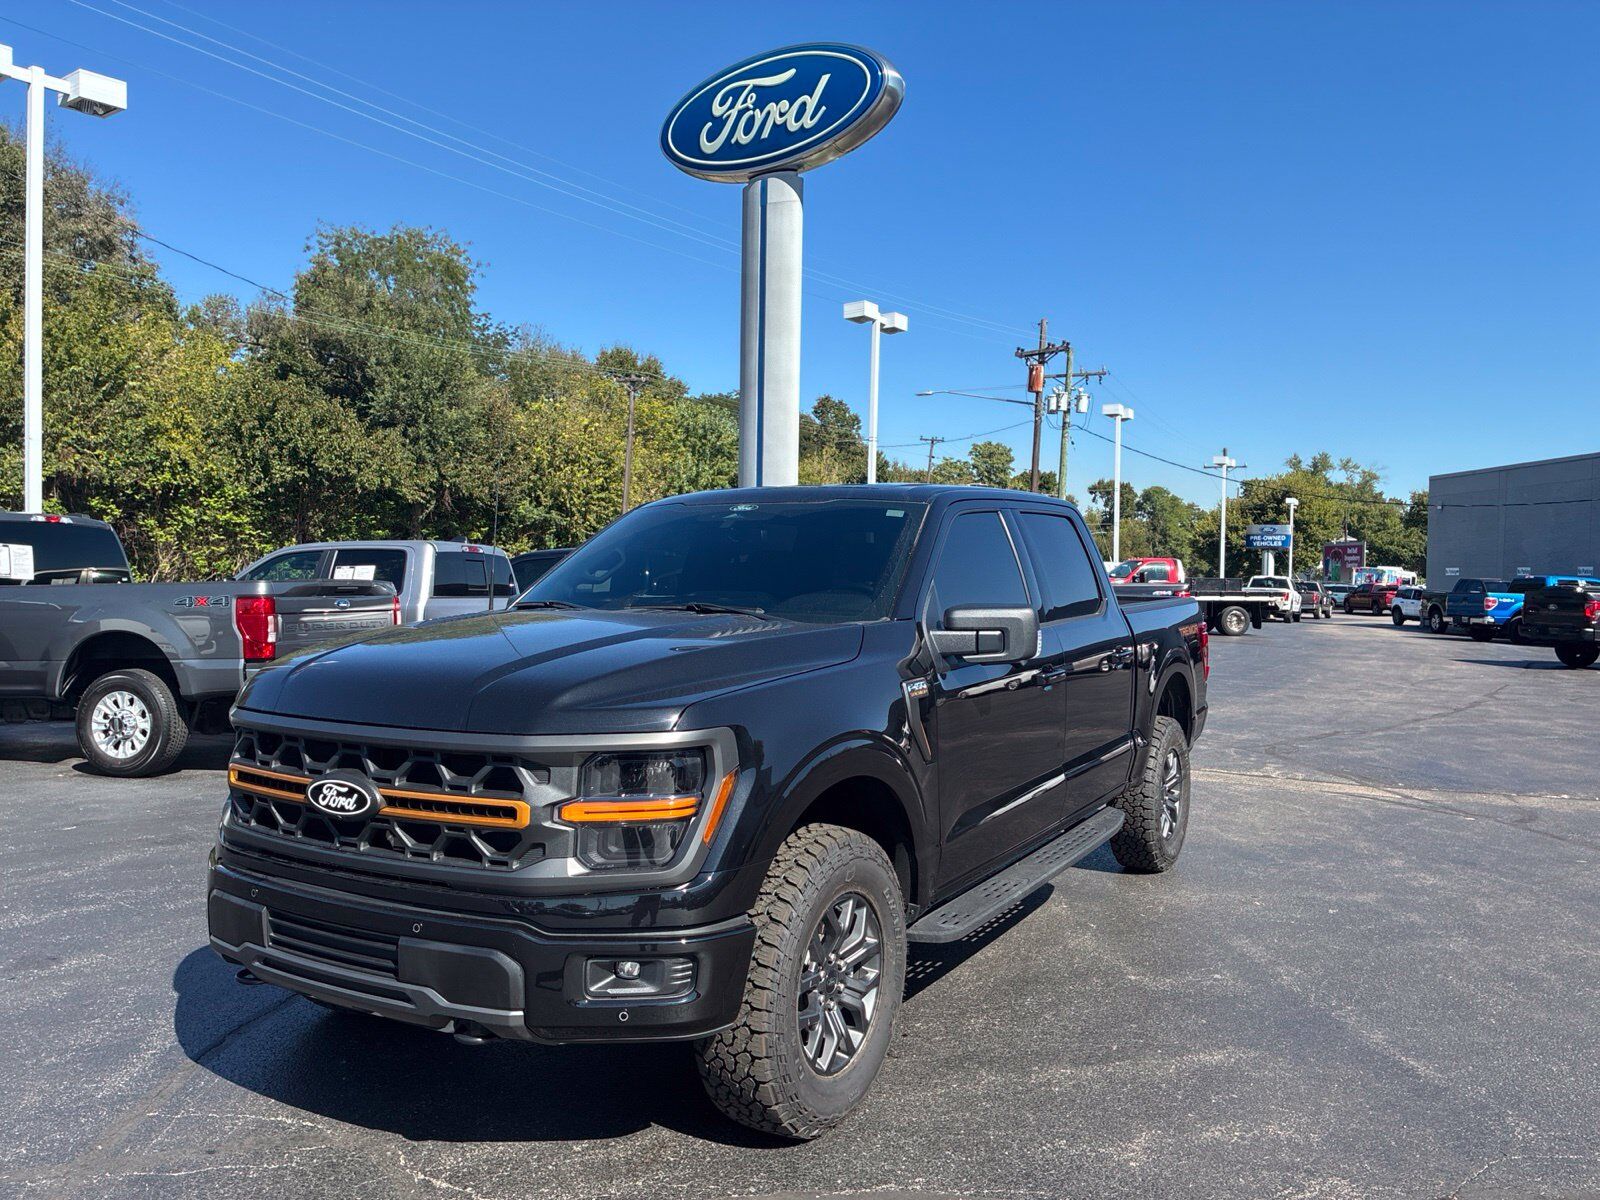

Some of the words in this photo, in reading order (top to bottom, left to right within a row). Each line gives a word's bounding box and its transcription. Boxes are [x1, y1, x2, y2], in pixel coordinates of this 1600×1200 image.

[699, 68, 832, 155] Ford
[285, 621, 346, 633] SUPER
[349, 617, 388, 629] DUTY
[318, 783, 358, 811] Ford
